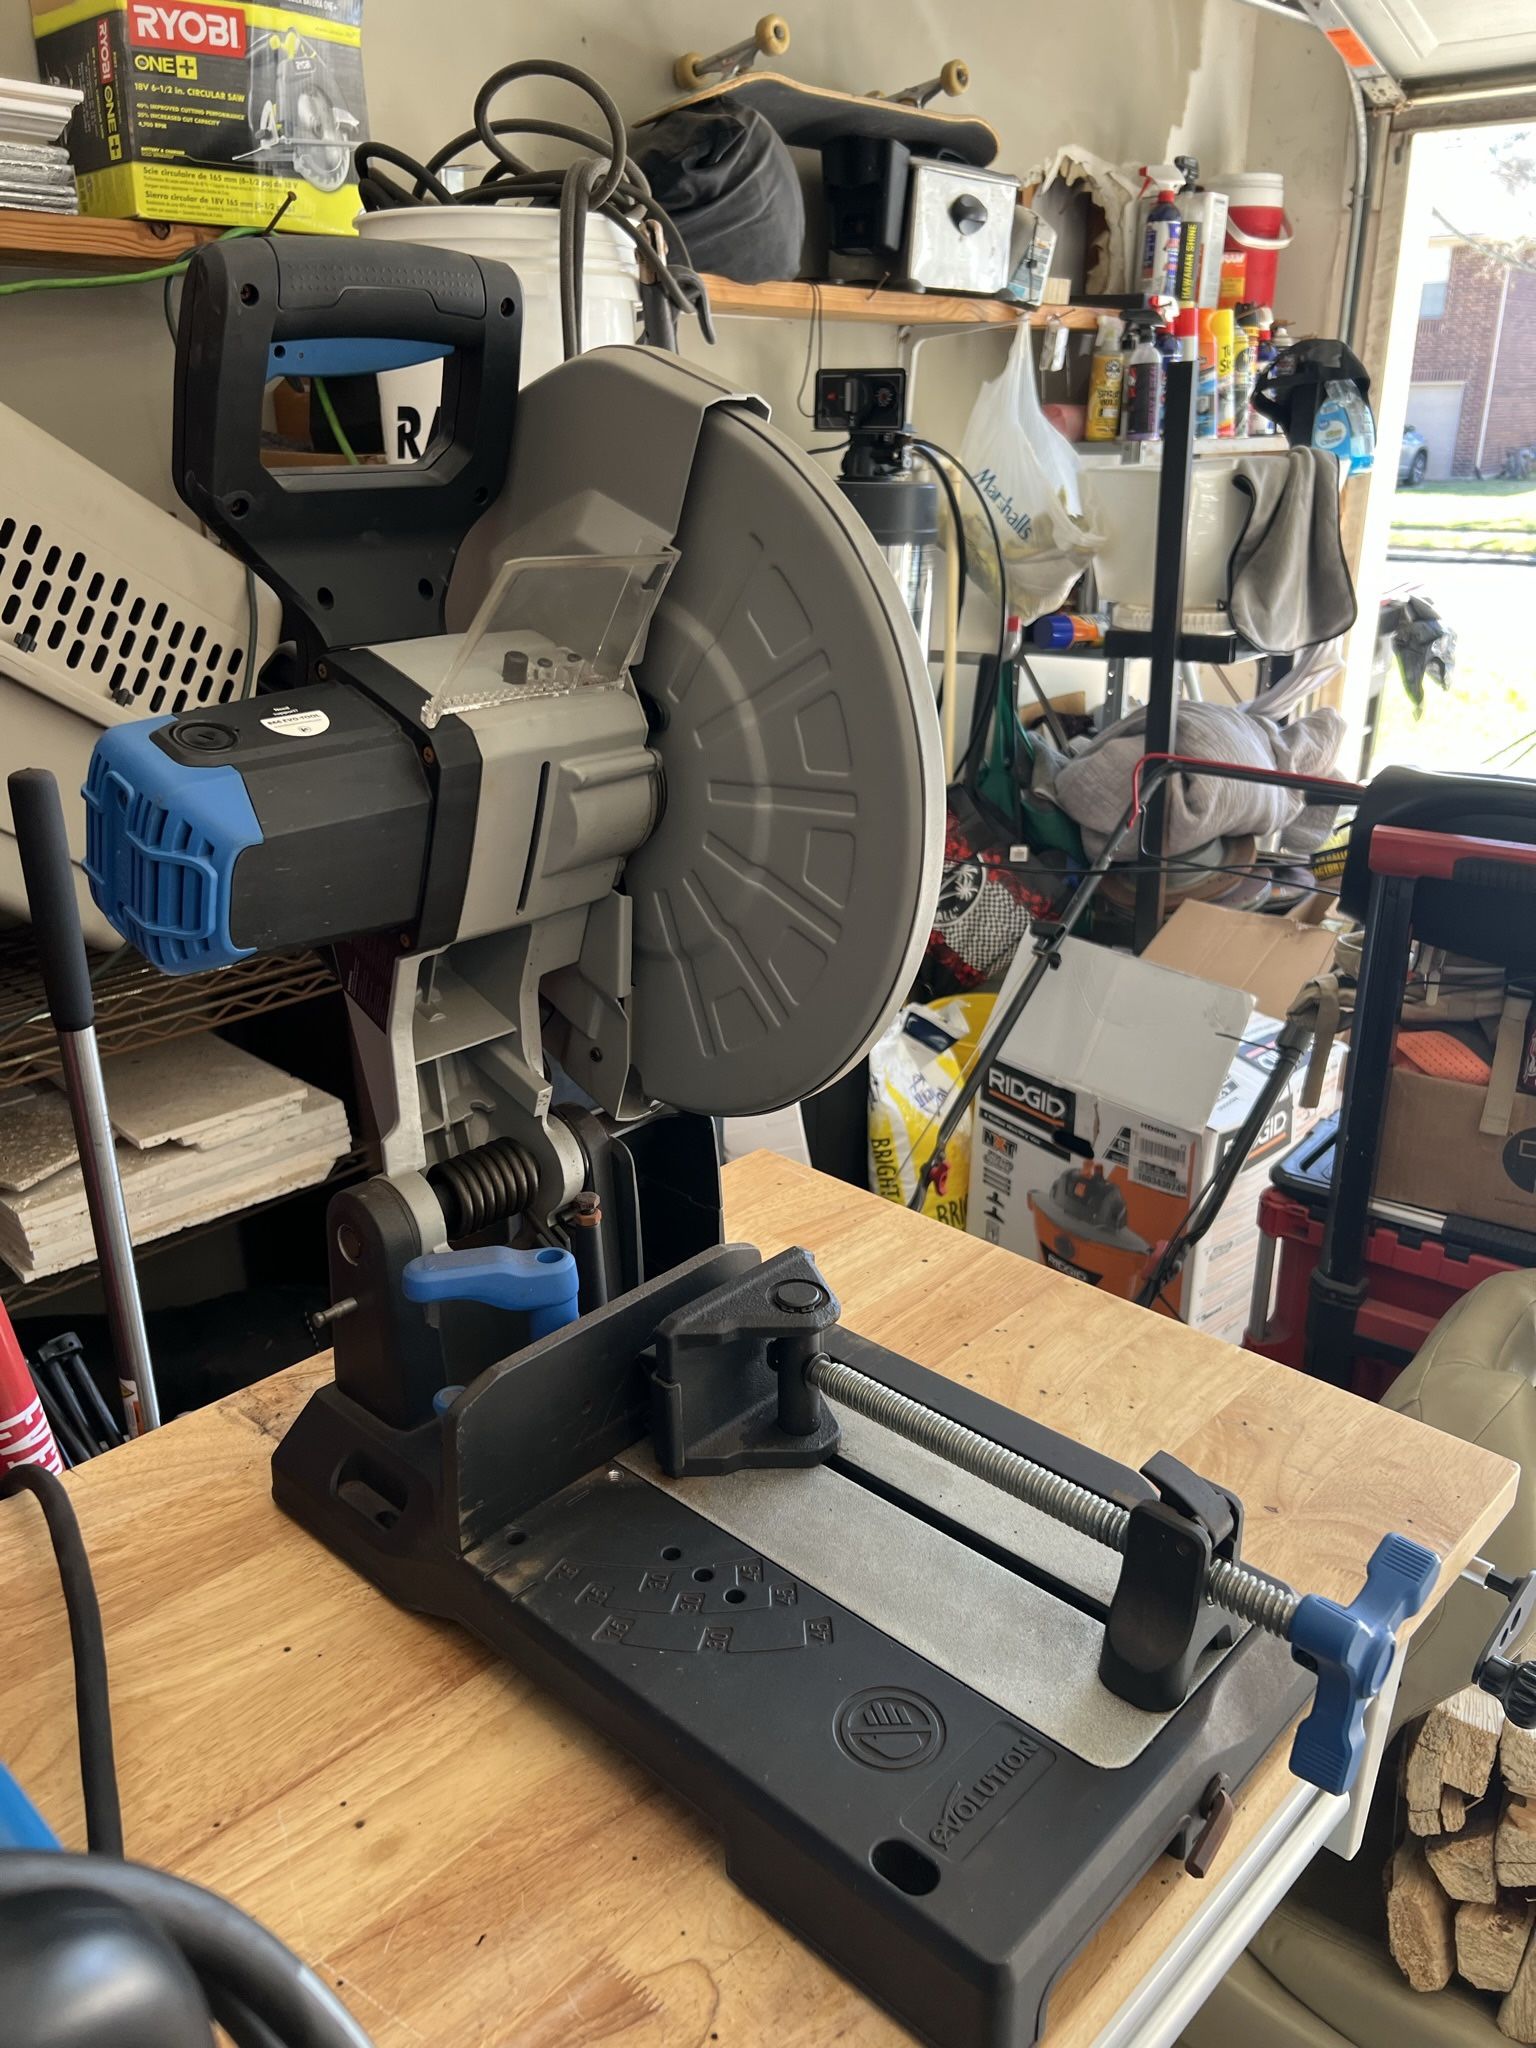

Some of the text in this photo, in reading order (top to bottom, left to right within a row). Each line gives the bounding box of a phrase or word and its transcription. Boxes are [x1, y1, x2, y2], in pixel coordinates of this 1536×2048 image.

[133, 4, 239, 49] RYOBI
[99, 21, 111, 80] RYOBI
[134, 82, 246, 102] 18V 6-1/2 in. CIRCULAR SAW
[143, 166, 158, 175] Scie
[161, 167, 195, 178] circulaire
[197, 171, 207, 179] de
[209, 174, 222, 182] 165
[145, 190, 168, 200] Sierra
[170, 192, 197, 202] circular
[199, 194, 209, 203] de
[211, 197, 225, 205] 18V
[226, 198, 238, 206] 165
[989, 1067, 1066, 1119] RIDGID
[983, 1127, 1017, 1158] NXT
[871, 1137, 900, 1199] BRIGHT
[936, 1193, 968, 1228] BRI
[706, 1631, 729, 1648] 30
[809, 1623, 830, 1641] 45
